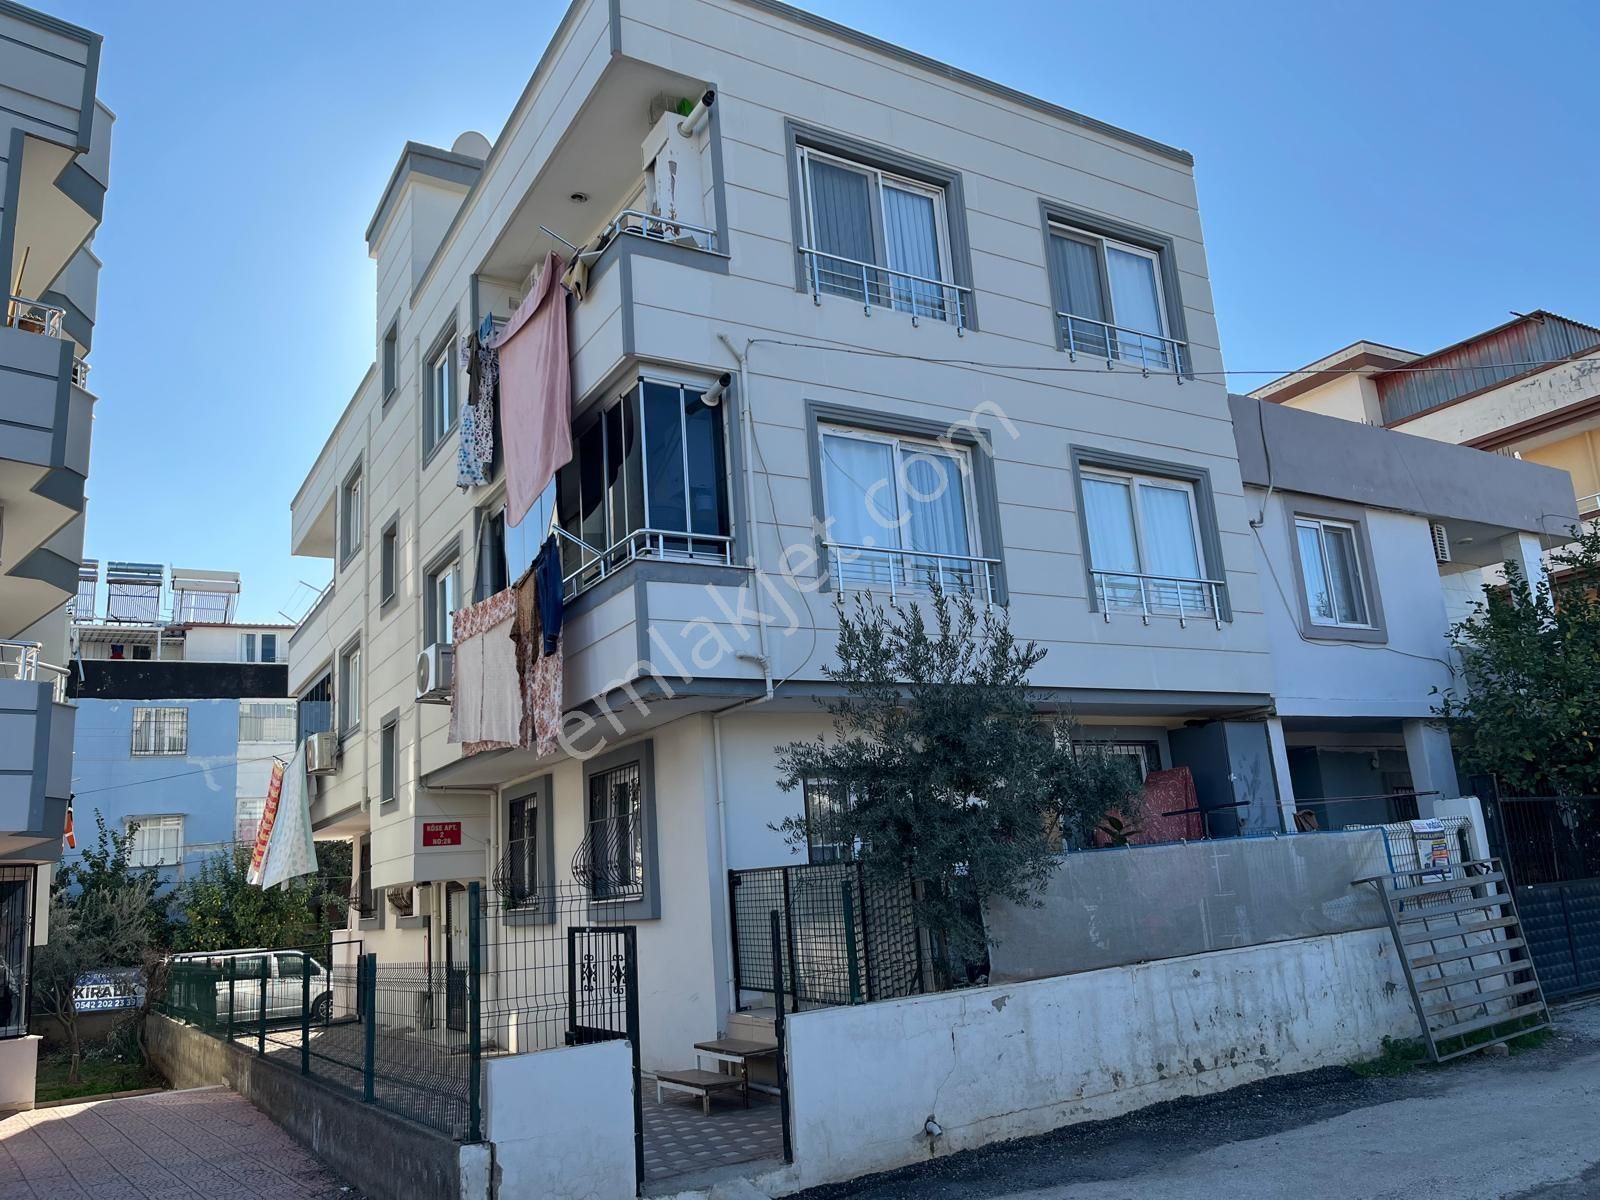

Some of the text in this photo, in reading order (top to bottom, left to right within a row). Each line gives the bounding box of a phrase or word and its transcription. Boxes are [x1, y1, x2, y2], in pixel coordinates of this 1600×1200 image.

[73, 984, 137, 999] KIRALIK
[75, 1001, 96, 1009] 0542
[97, 1000, 113, 1008] 202
[114, 999, 125, 1007] 23
